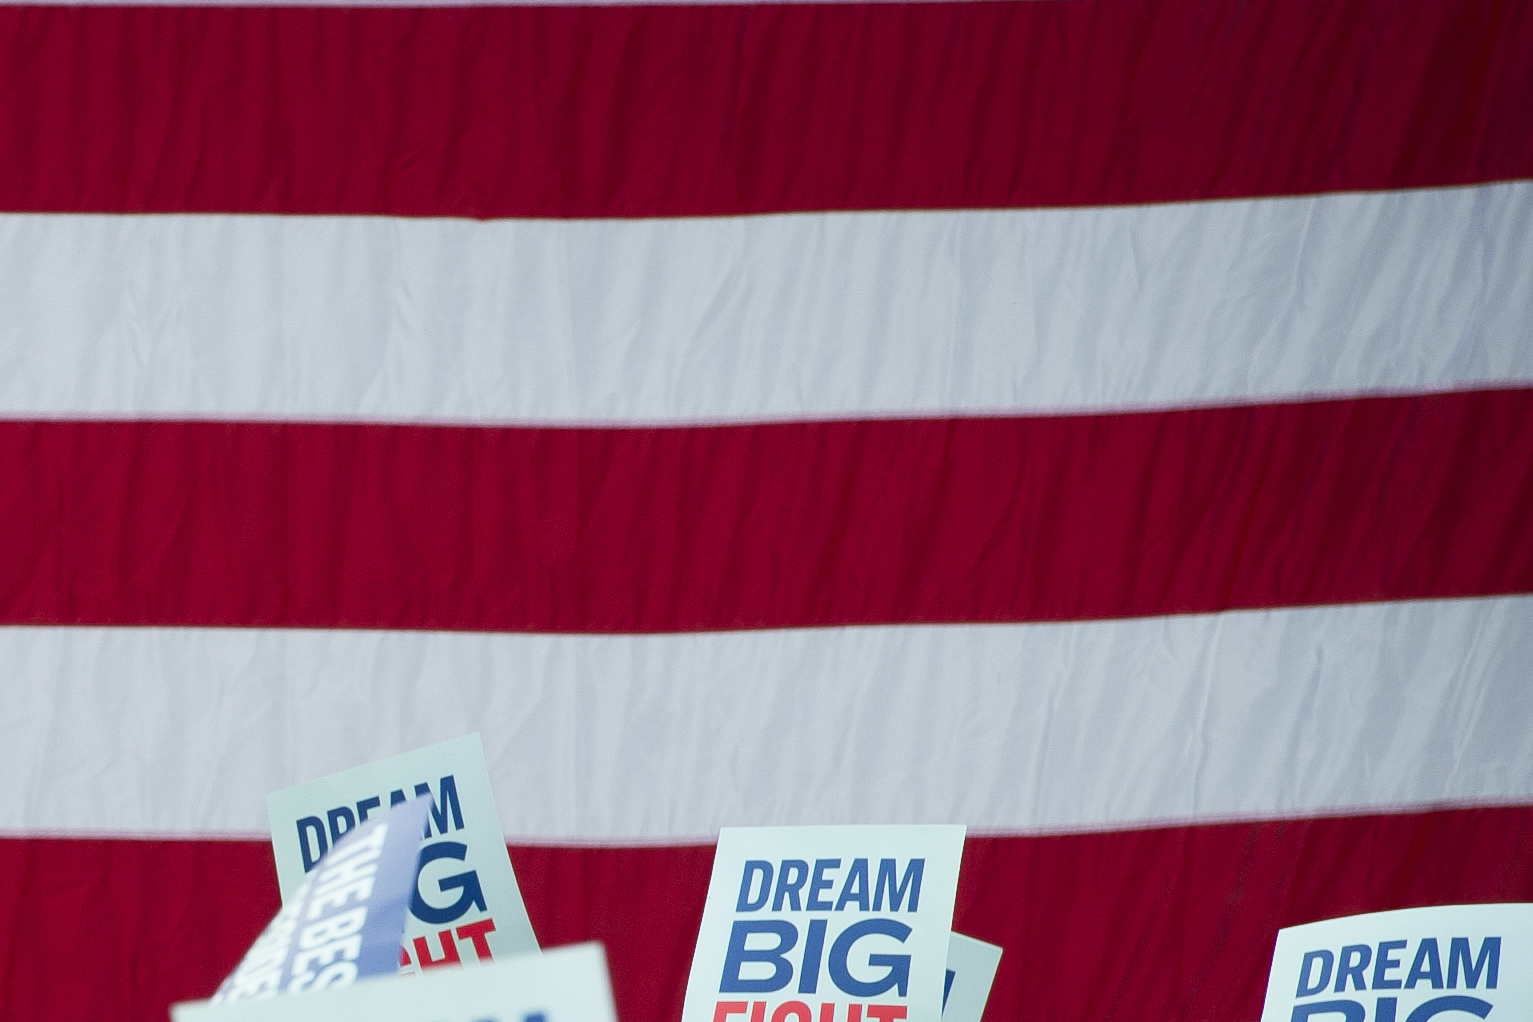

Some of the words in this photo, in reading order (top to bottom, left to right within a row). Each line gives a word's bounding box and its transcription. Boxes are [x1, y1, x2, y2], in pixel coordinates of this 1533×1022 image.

[736, 858, 926, 913] DREAM
[288, 906, 369, 992] BES
[719, 918, 913, 998] BIG
[1296, 937, 1502, 998] DREAM
